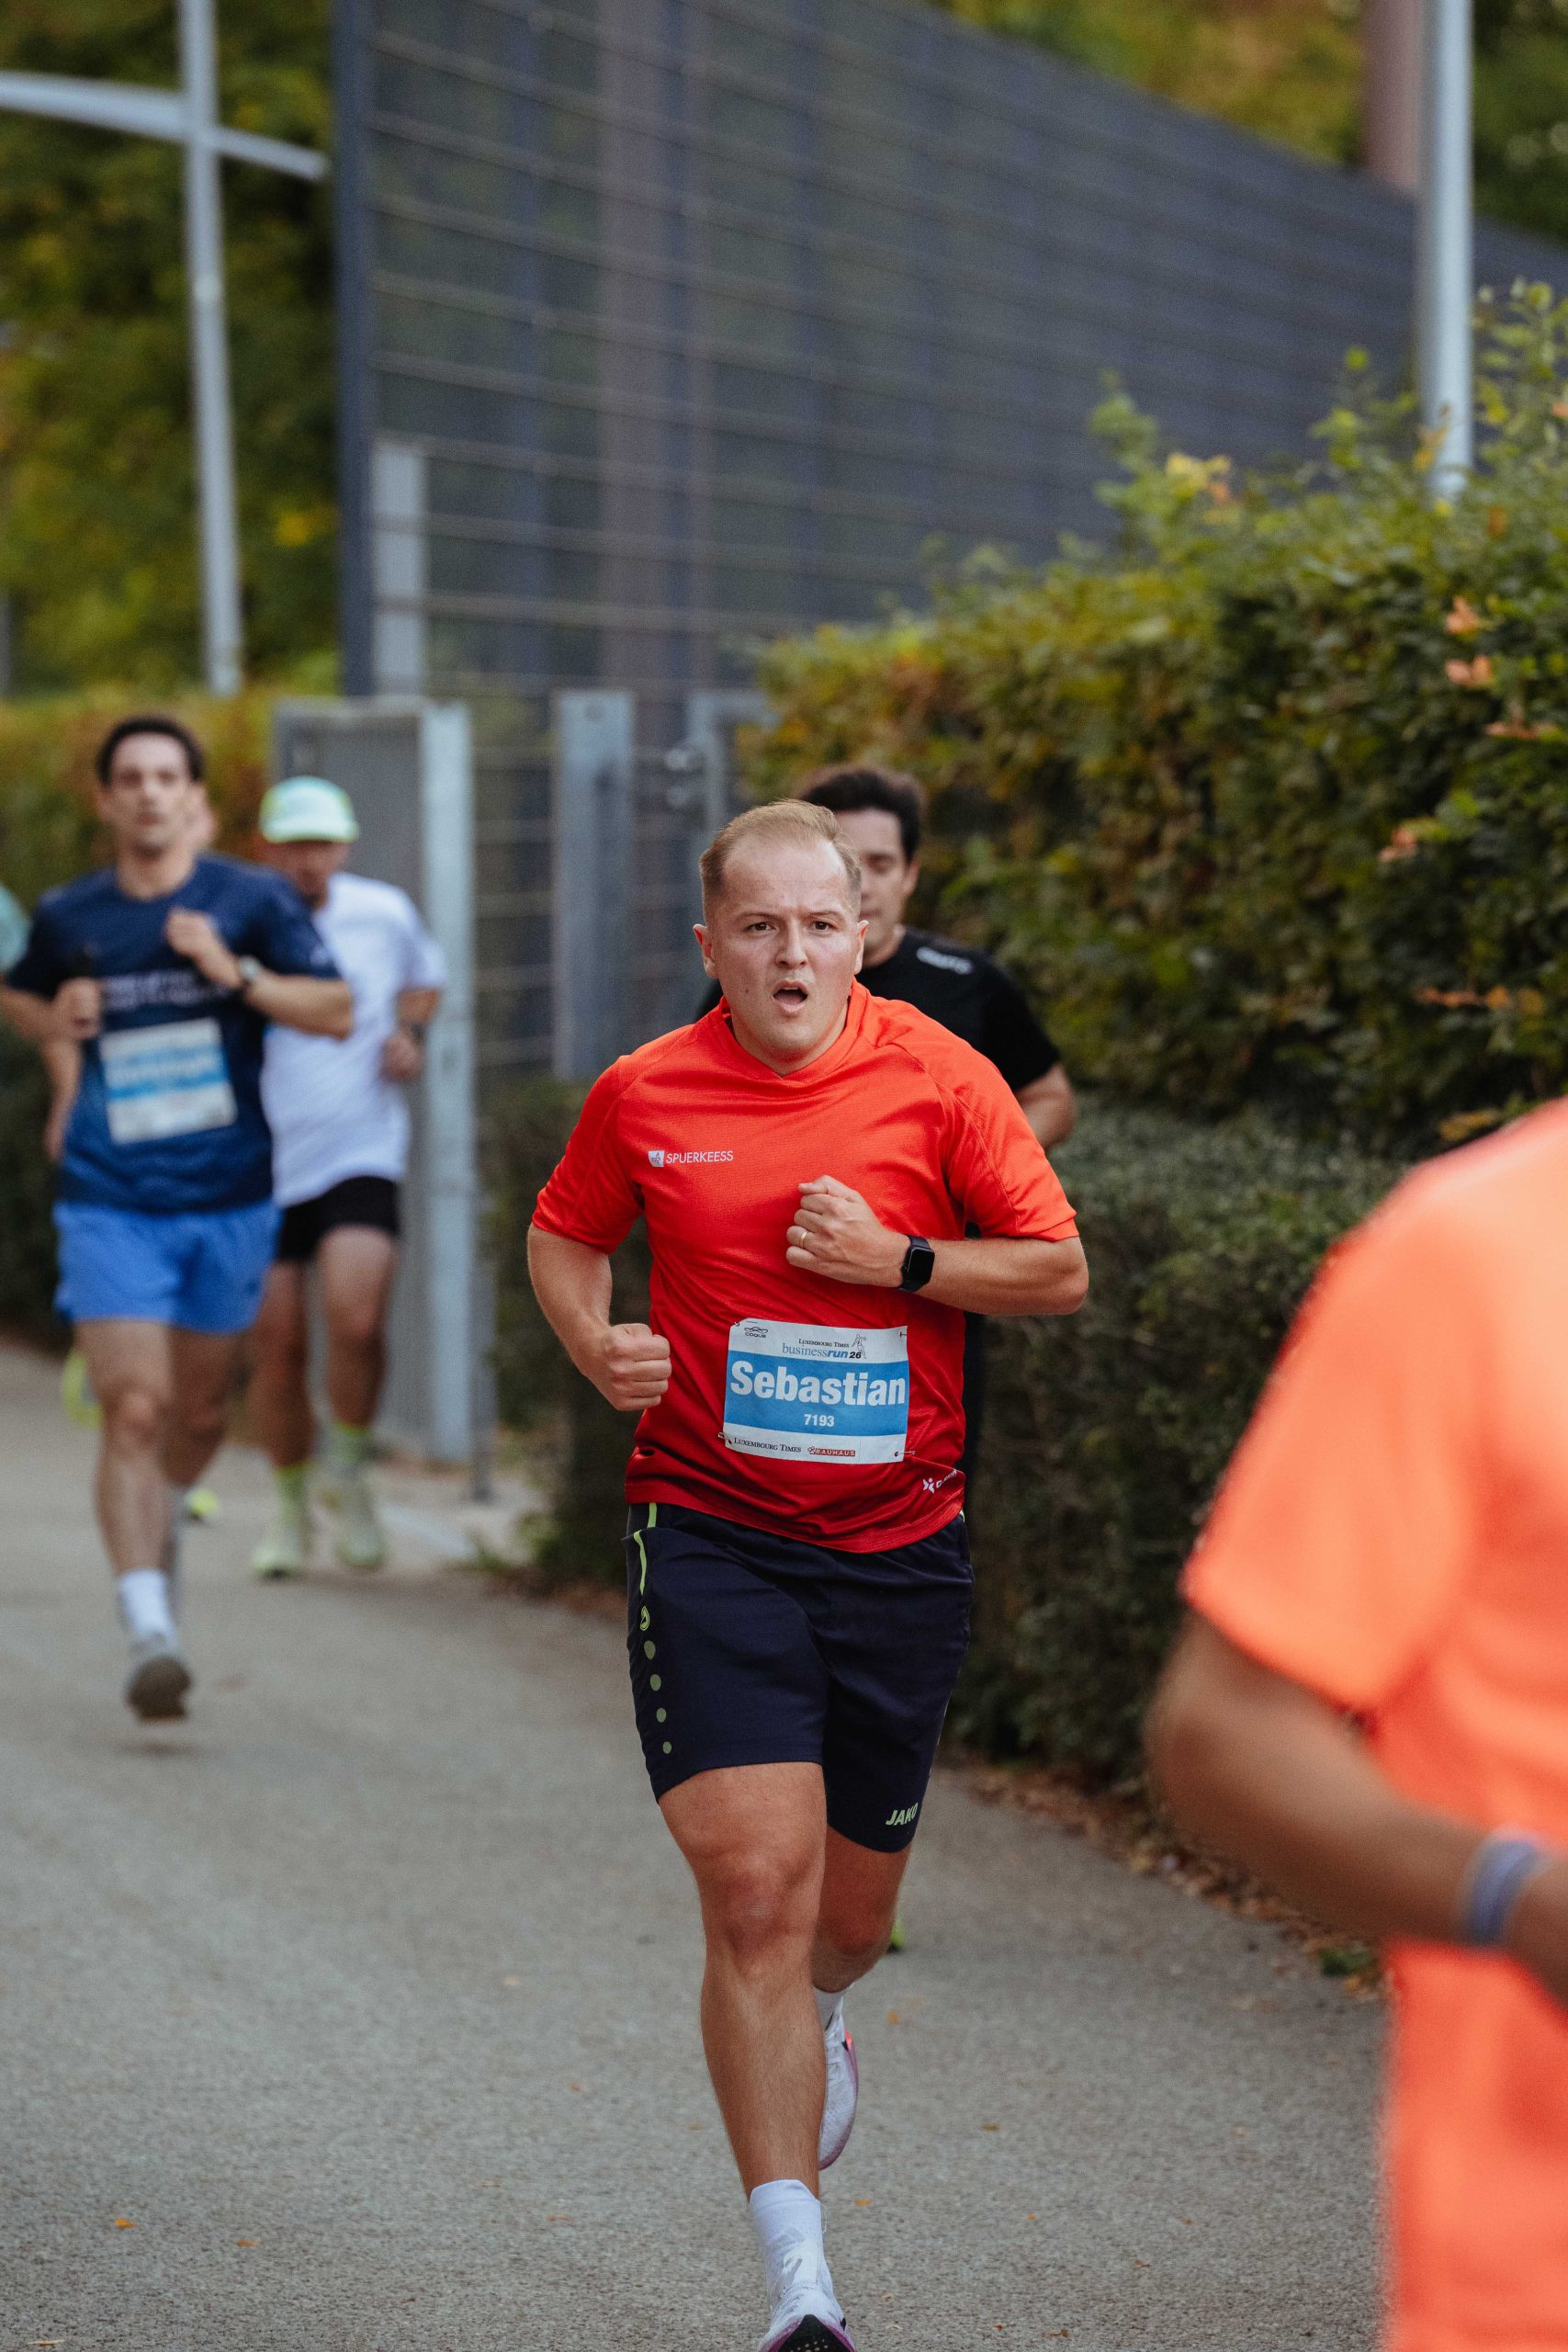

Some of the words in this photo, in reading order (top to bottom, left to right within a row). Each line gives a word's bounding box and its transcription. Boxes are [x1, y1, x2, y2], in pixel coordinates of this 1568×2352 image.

[666, 1150, 734, 1164] SPUERKEESS
[798, 1338, 833, 1348] LUXEMBOURG
[730, 1360, 906, 1407] Sebastian
[804, 1413, 835, 1428] 7193
[734, 1437, 778, 1451] LUXEMBOURG
[779, 1443, 802, 1453] TIMES
[816, 1449, 855, 1457] BAUHAUS
[886, 1802, 919, 1826] JAKO
